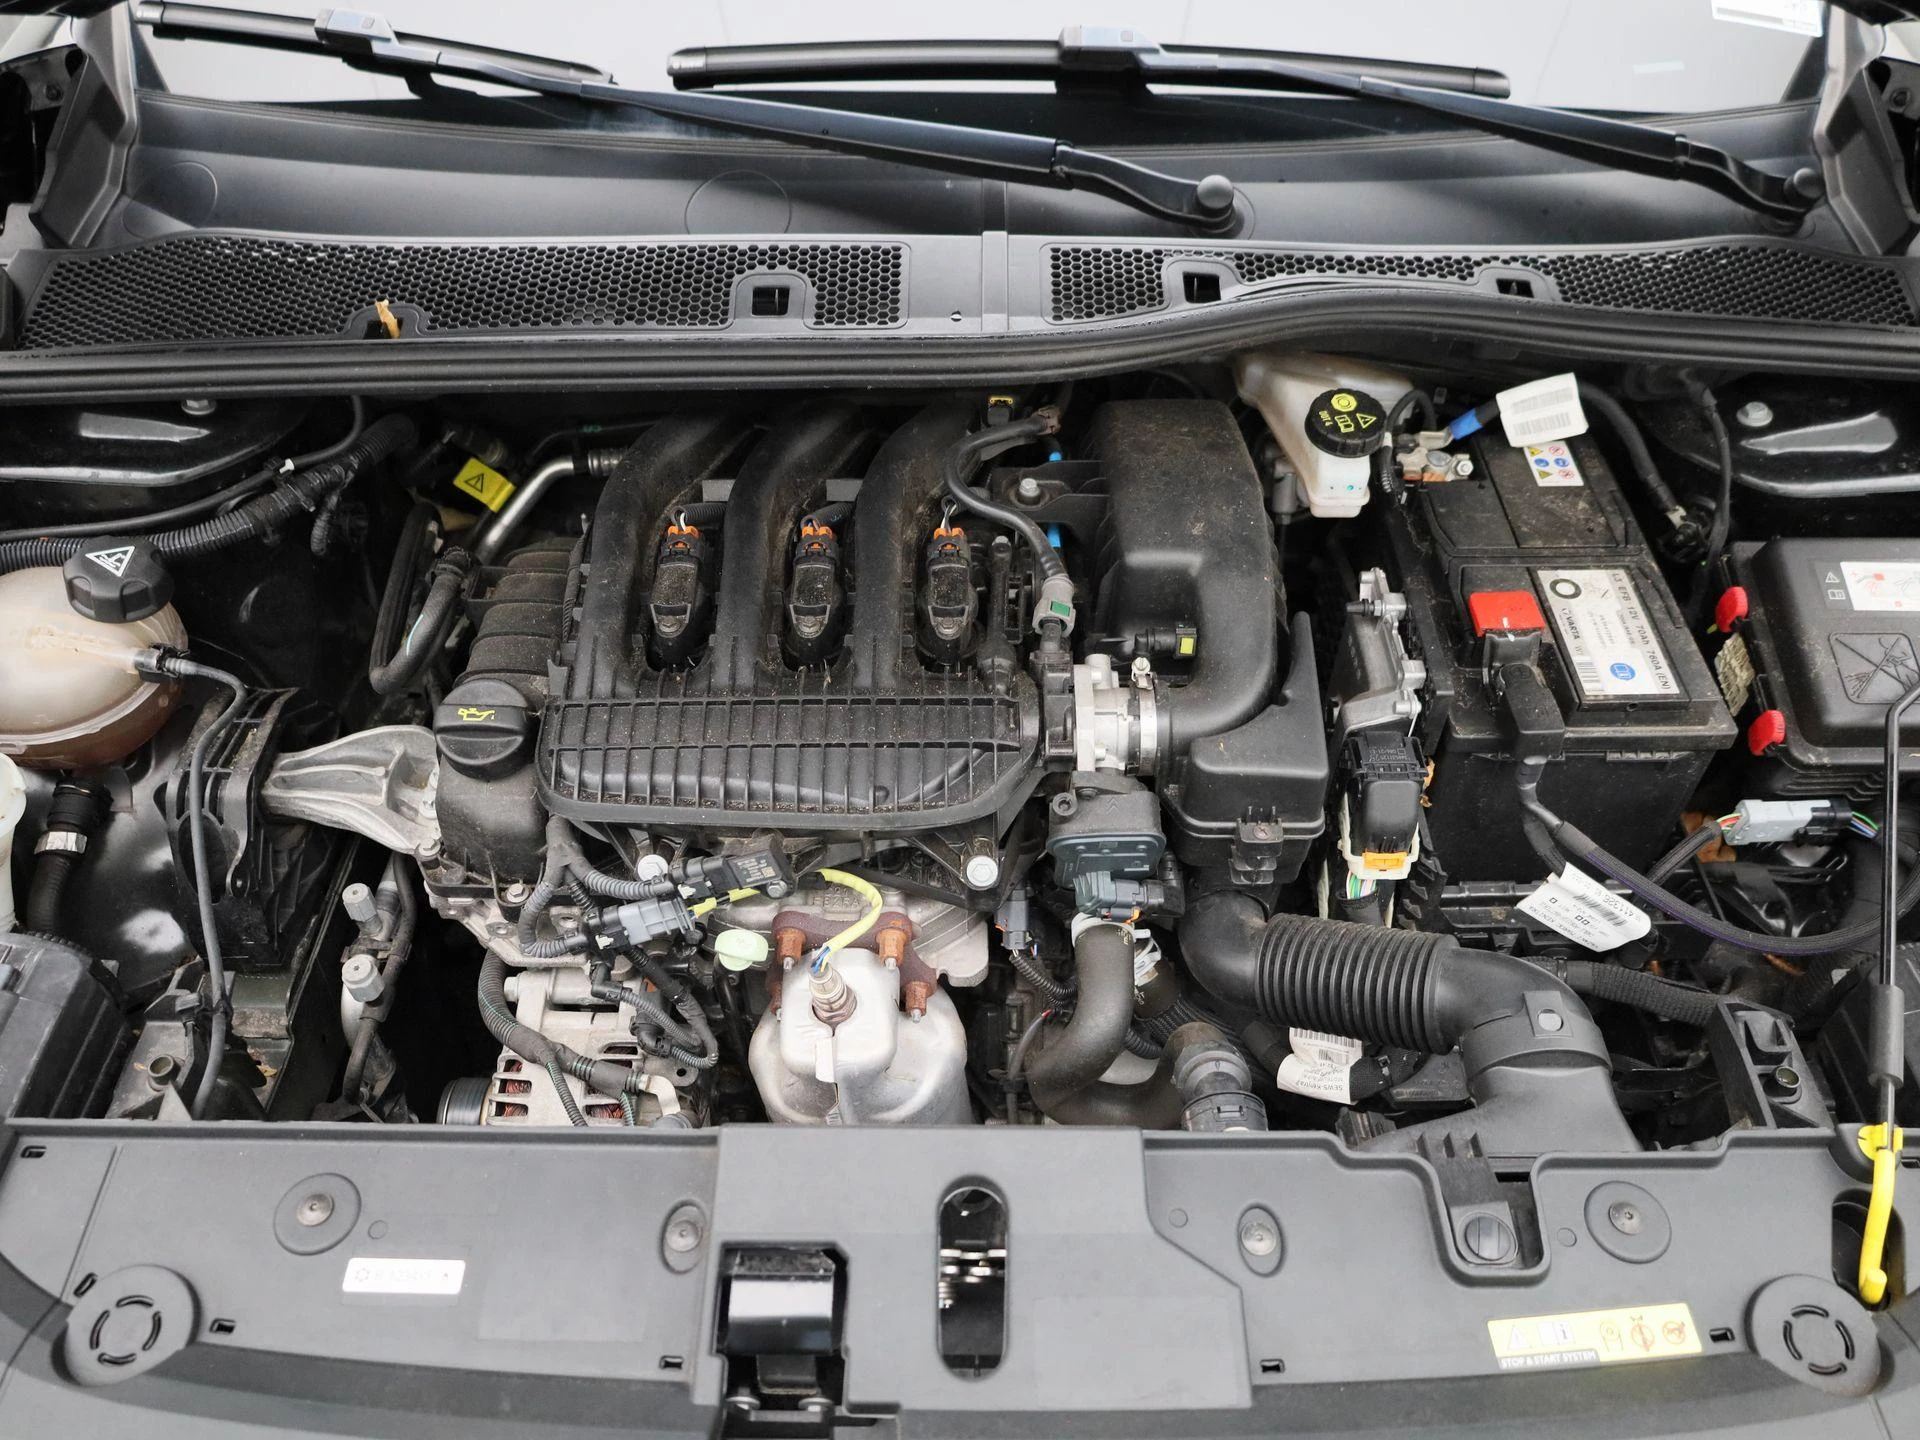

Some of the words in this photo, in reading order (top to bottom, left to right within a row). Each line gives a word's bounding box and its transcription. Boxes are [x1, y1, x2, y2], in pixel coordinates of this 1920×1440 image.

[1566, 616, 1581, 640] VARTA
[1618, 586, 1631, 602] EFB
[1628, 607, 1640, 620] 12V
[1636, 625, 1649, 644] 70Ah
[1647, 650, 1662, 671] 760A
[1656, 671, 1671, 690] (EN)
[1501, 1356, 1526, 1368] STOP
[1534, 1353, 1562, 1364] START
[1563, 1350, 1597, 1362] SYSTEM
